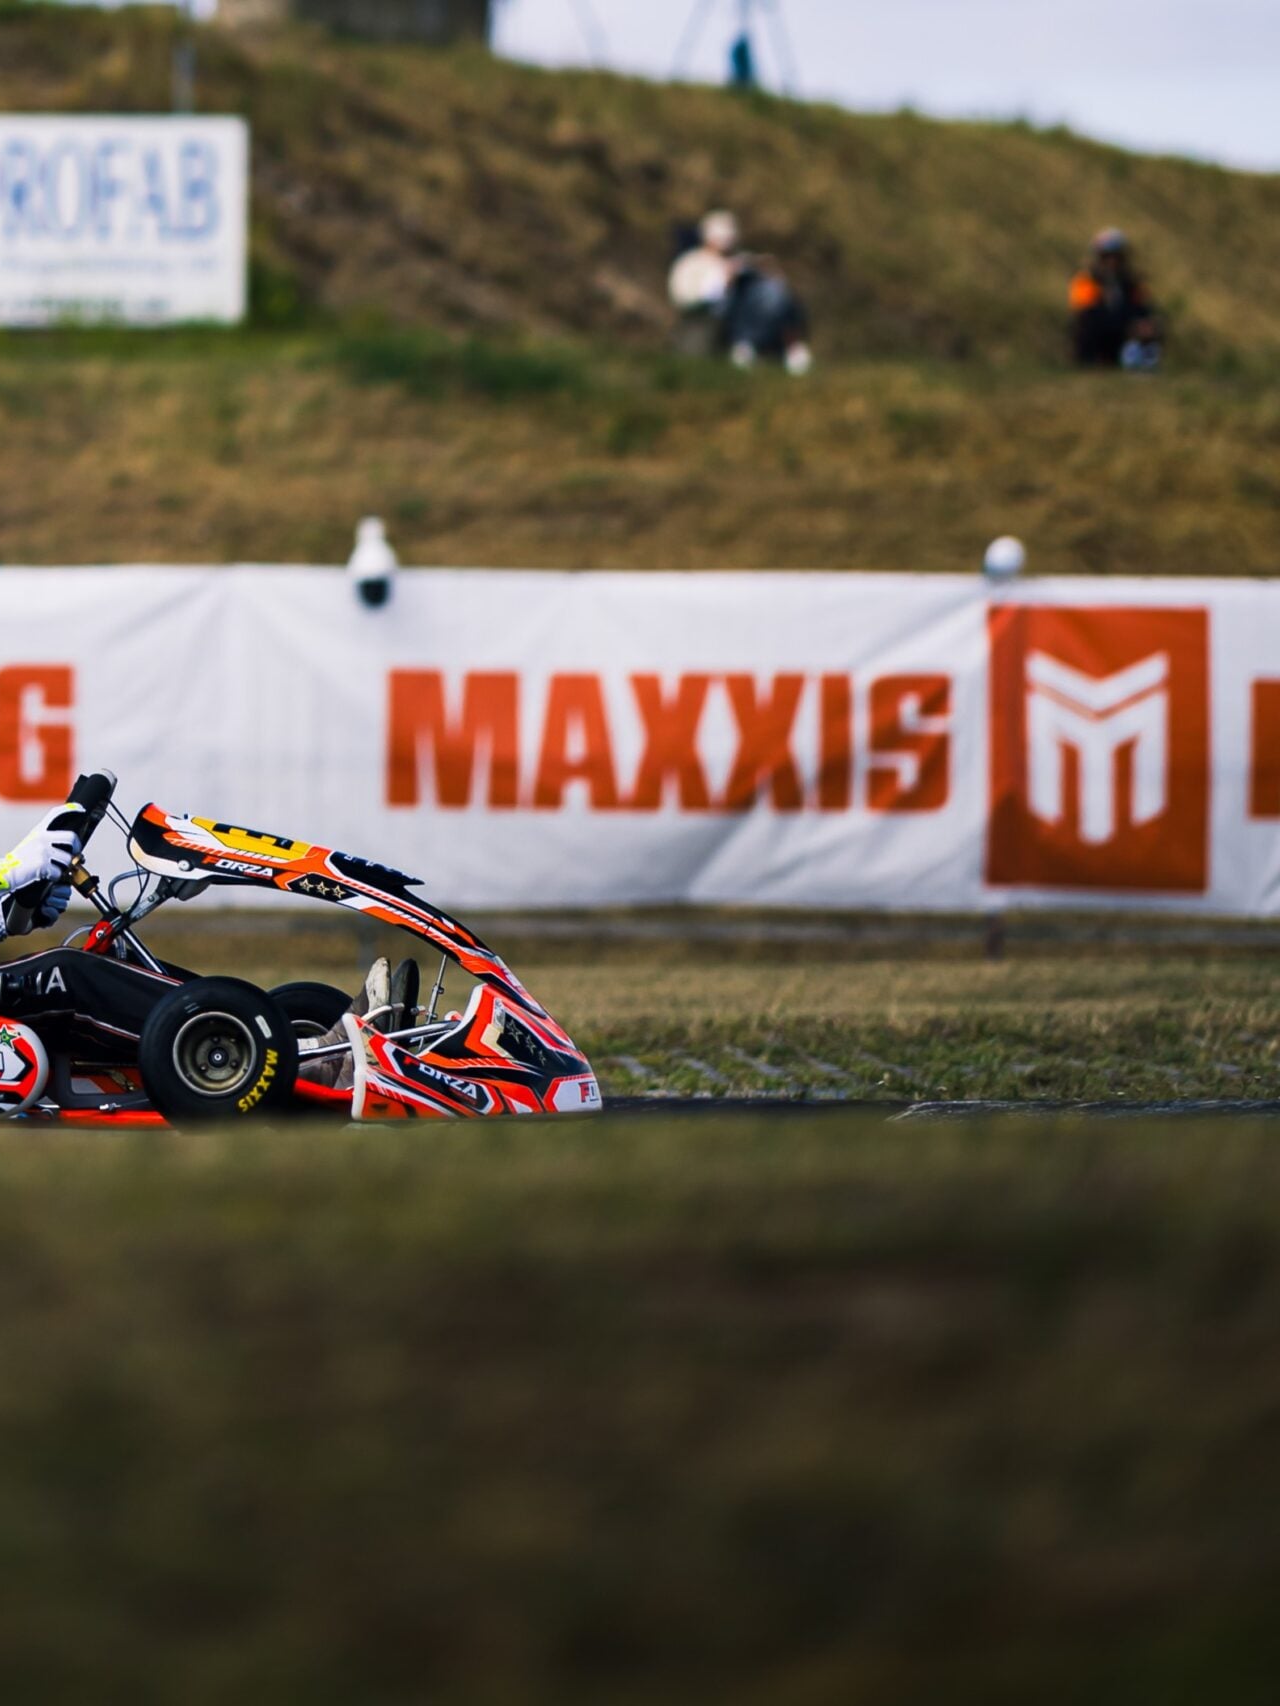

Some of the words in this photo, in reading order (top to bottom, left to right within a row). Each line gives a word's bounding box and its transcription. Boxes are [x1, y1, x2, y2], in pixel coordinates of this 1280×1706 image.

[386, 669, 951, 814] MAXXIS
[202, 856, 273, 877] FORZA
[238, 1048, 278, 1112] MAXXIS
[403, 1055, 477, 1099] FORZA
